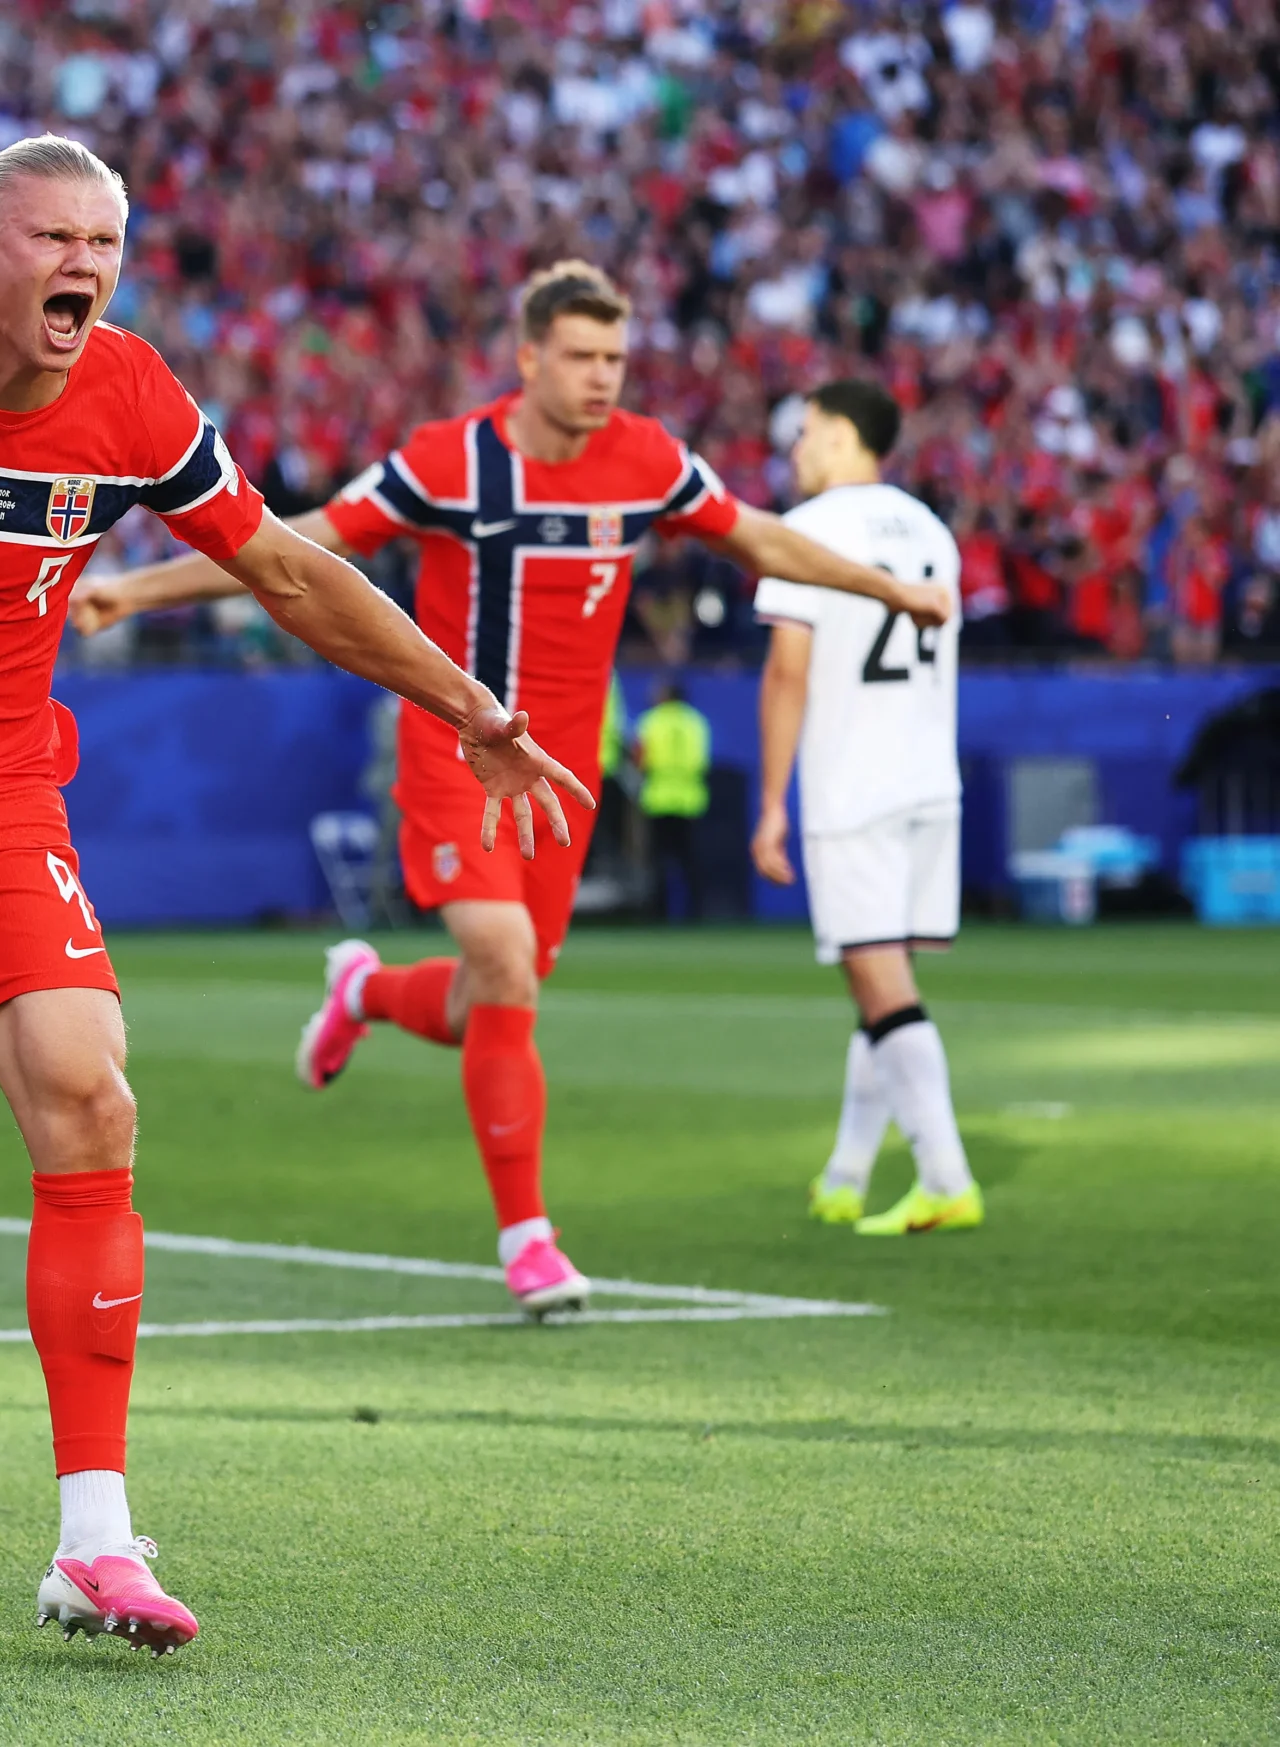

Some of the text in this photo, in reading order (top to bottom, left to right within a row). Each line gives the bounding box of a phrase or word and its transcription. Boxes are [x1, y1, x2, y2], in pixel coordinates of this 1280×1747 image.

[26, 553, 74, 618] 9
[581, 562, 618, 619] 7
[47, 851, 96, 932] 9
